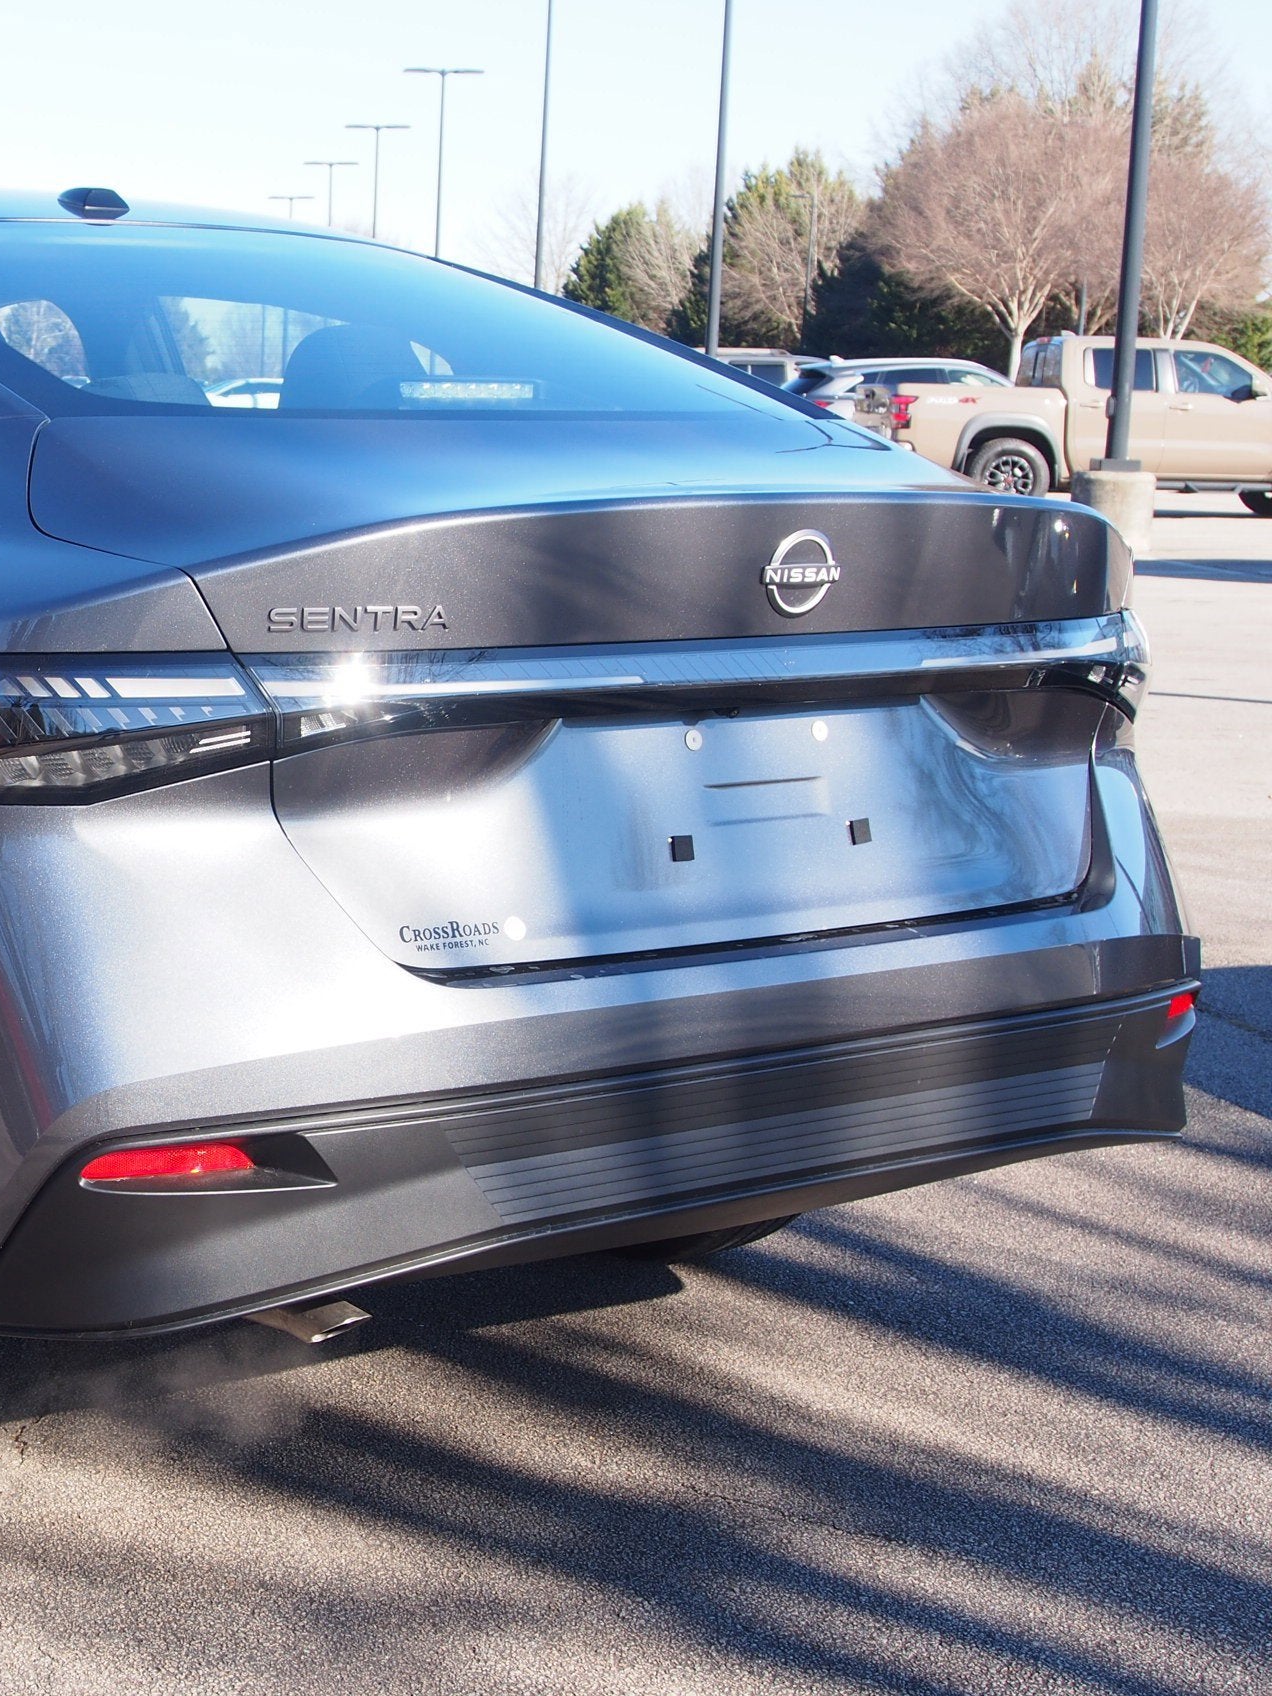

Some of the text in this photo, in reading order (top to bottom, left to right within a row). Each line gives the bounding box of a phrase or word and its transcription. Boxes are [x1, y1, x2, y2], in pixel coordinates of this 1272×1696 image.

[765, 566, 841, 583] NISSAN
[268, 604, 450, 632] SENTRA
[416, 938, 490, 952] WAKE FOREST, NC
